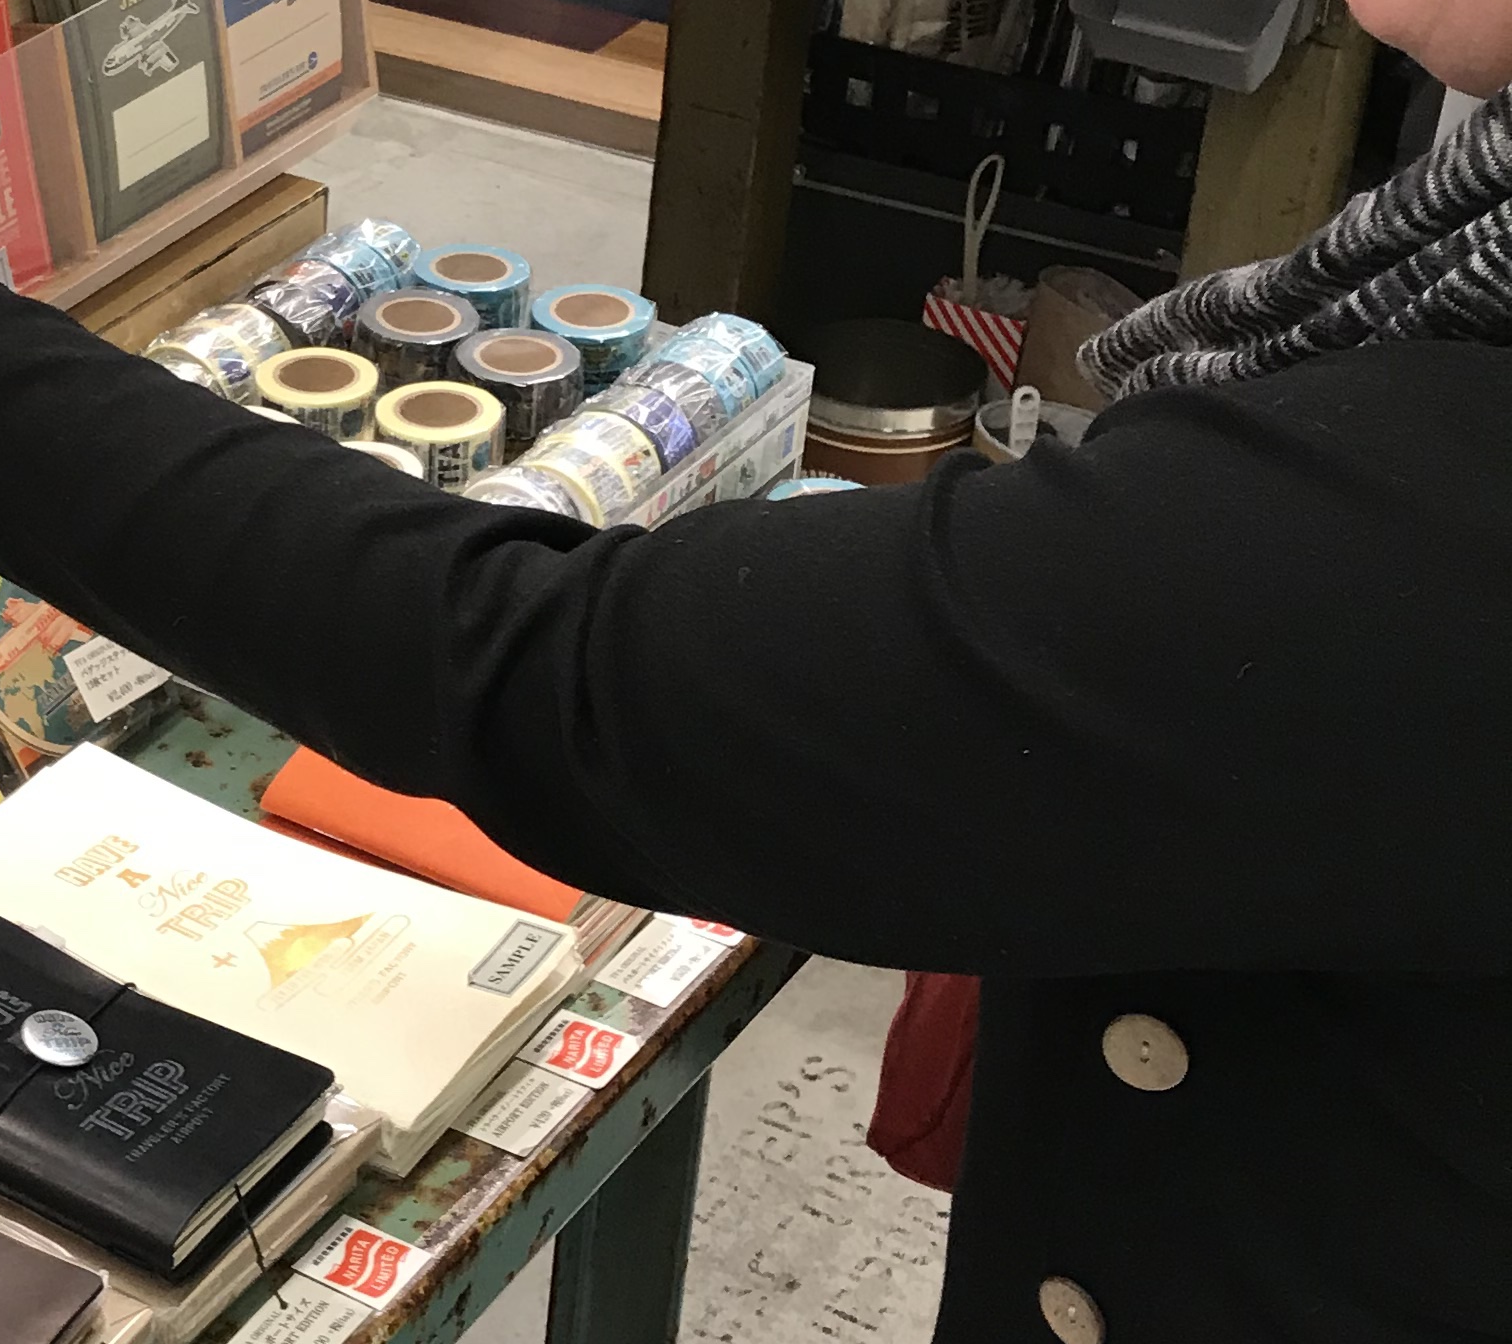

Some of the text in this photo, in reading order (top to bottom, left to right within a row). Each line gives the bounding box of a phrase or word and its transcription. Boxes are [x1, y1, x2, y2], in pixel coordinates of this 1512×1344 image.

[54, 834, 140, 887] HAVE
[116, 868, 152, 889] A
[138, 869, 209, 919] Nice
[156, 877, 252, 942] TRIP
[488, 932, 541, 986] SAMPLE
[565, 1027, 587, 1065] NARITA
[590, 1033, 616, 1074] LIMITED
[53, 1049, 135, 1111] Nice
[79, 1058, 190, 1143] TRIP
[341, 1238, 372, 1281] NARITA
[370, 1245, 401, 1292] LIMITED
[298, 1299, 331, 1333] EDITION
